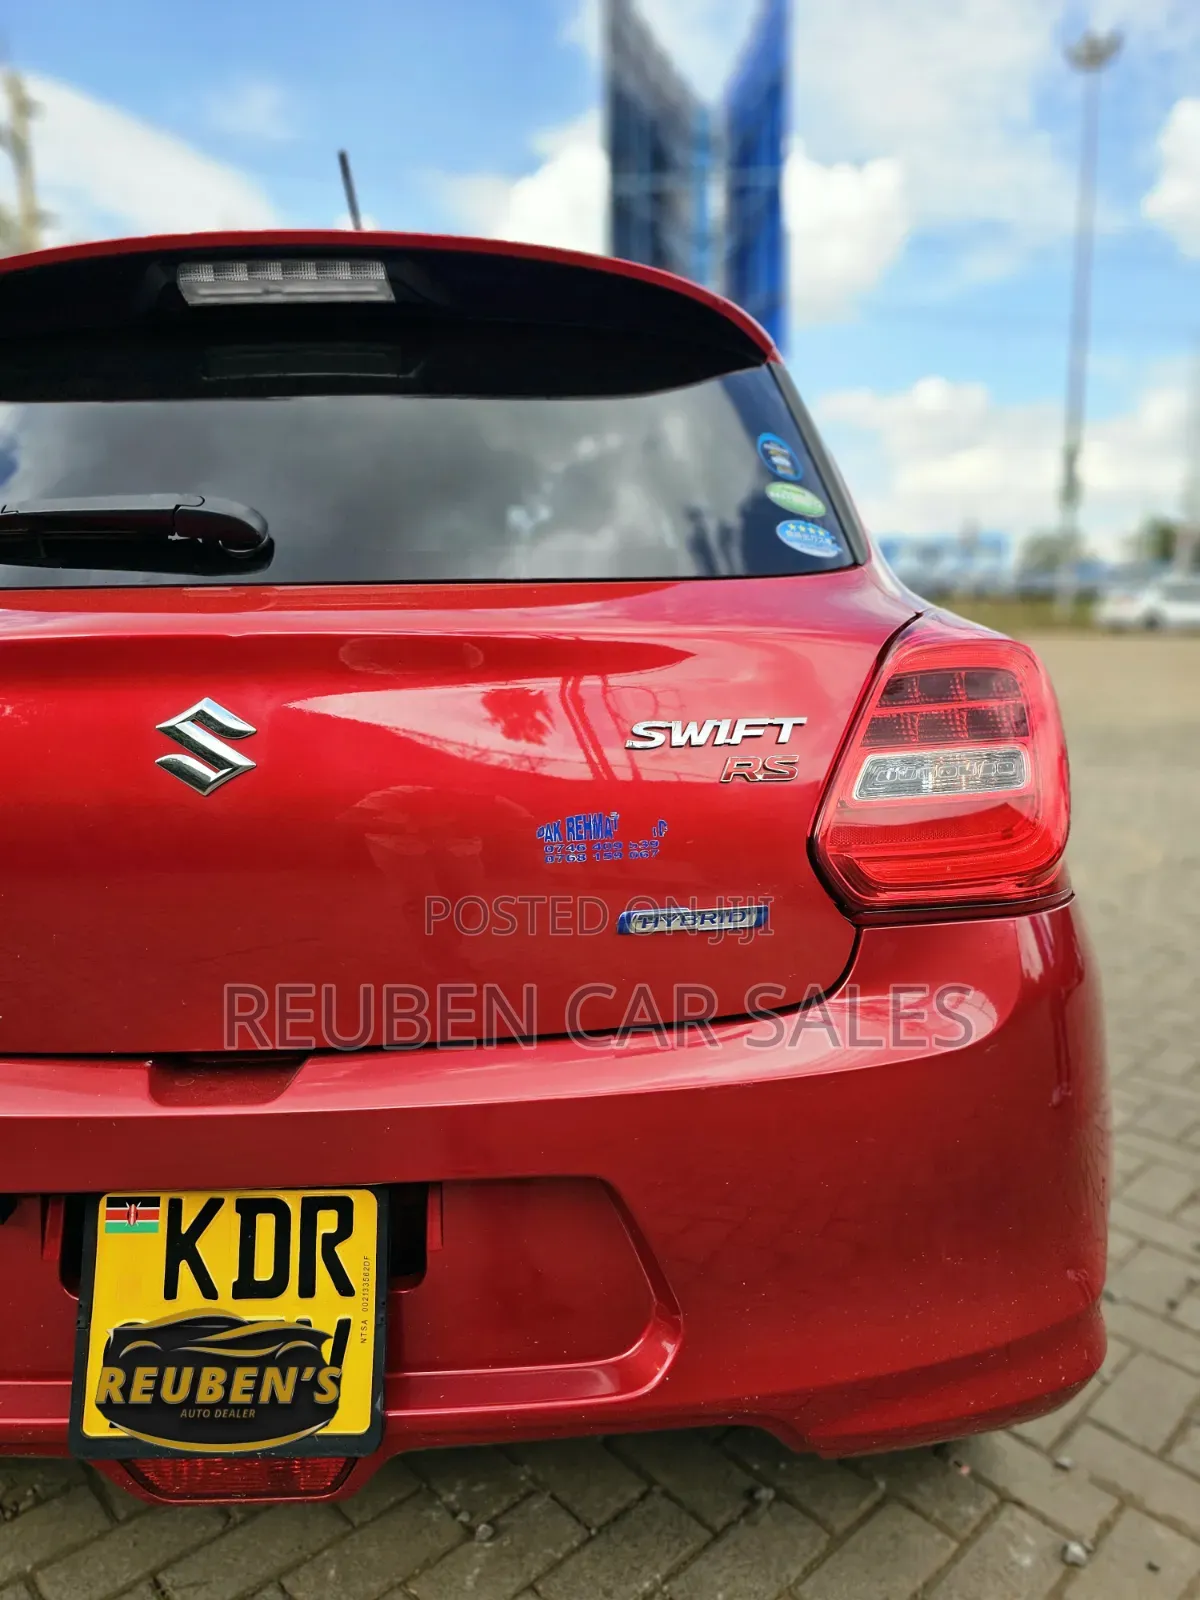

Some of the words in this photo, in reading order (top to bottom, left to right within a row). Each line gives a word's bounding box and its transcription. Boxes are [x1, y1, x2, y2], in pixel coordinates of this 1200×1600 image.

[625, 716, 808, 750] SWIFT
[719, 755, 799, 783] RS
[544, 843, 587, 854] 0746
[592, 841, 623, 851] 409
[544, 853, 587, 864] 0768
[593, 851, 623, 861] 159
[640, 910, 748, 930] HYBRID
[163, 1195, 356, 1301] KDR
[360, 1319, 369, 1344] NTSA
